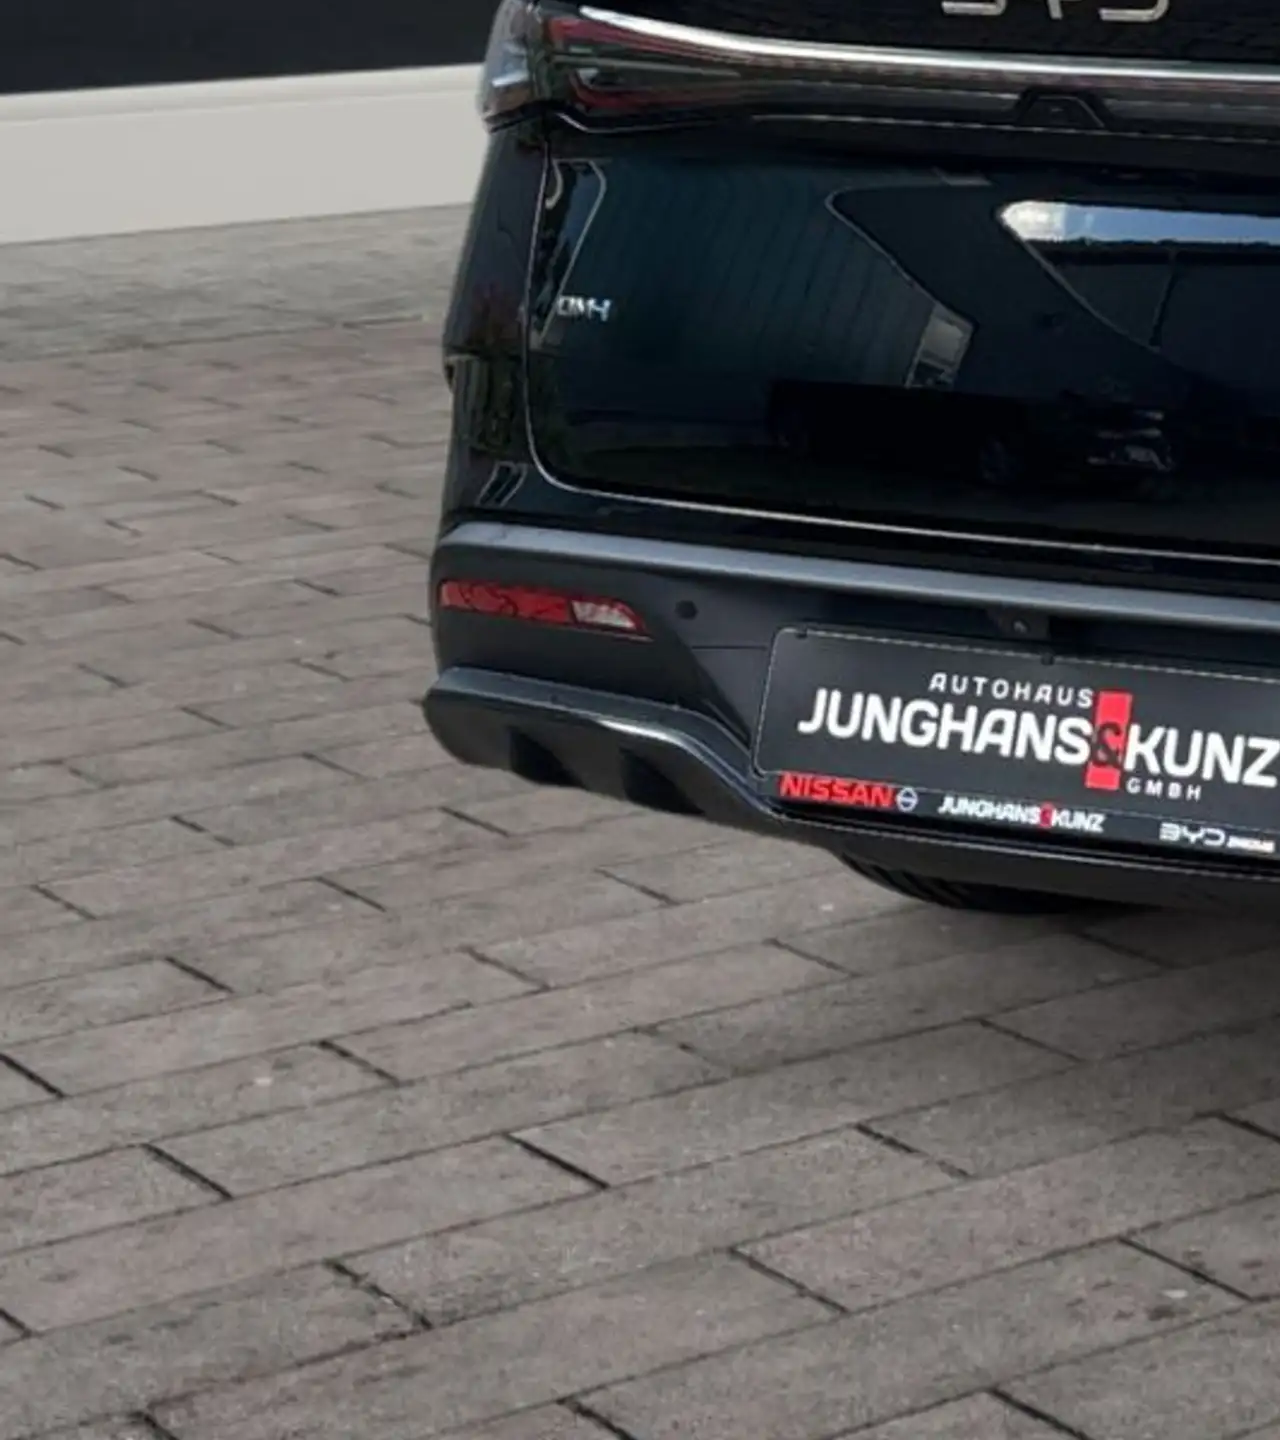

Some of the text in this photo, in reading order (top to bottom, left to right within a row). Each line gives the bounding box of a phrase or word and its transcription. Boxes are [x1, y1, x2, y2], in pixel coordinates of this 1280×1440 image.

[928, 672, 1094, 709] AUTOHAUS
[779, 773, 894, 808] NISSAN
[1125, 776, 1202, 803] GMBH
[1159, 822, 1226, 848] BYD
